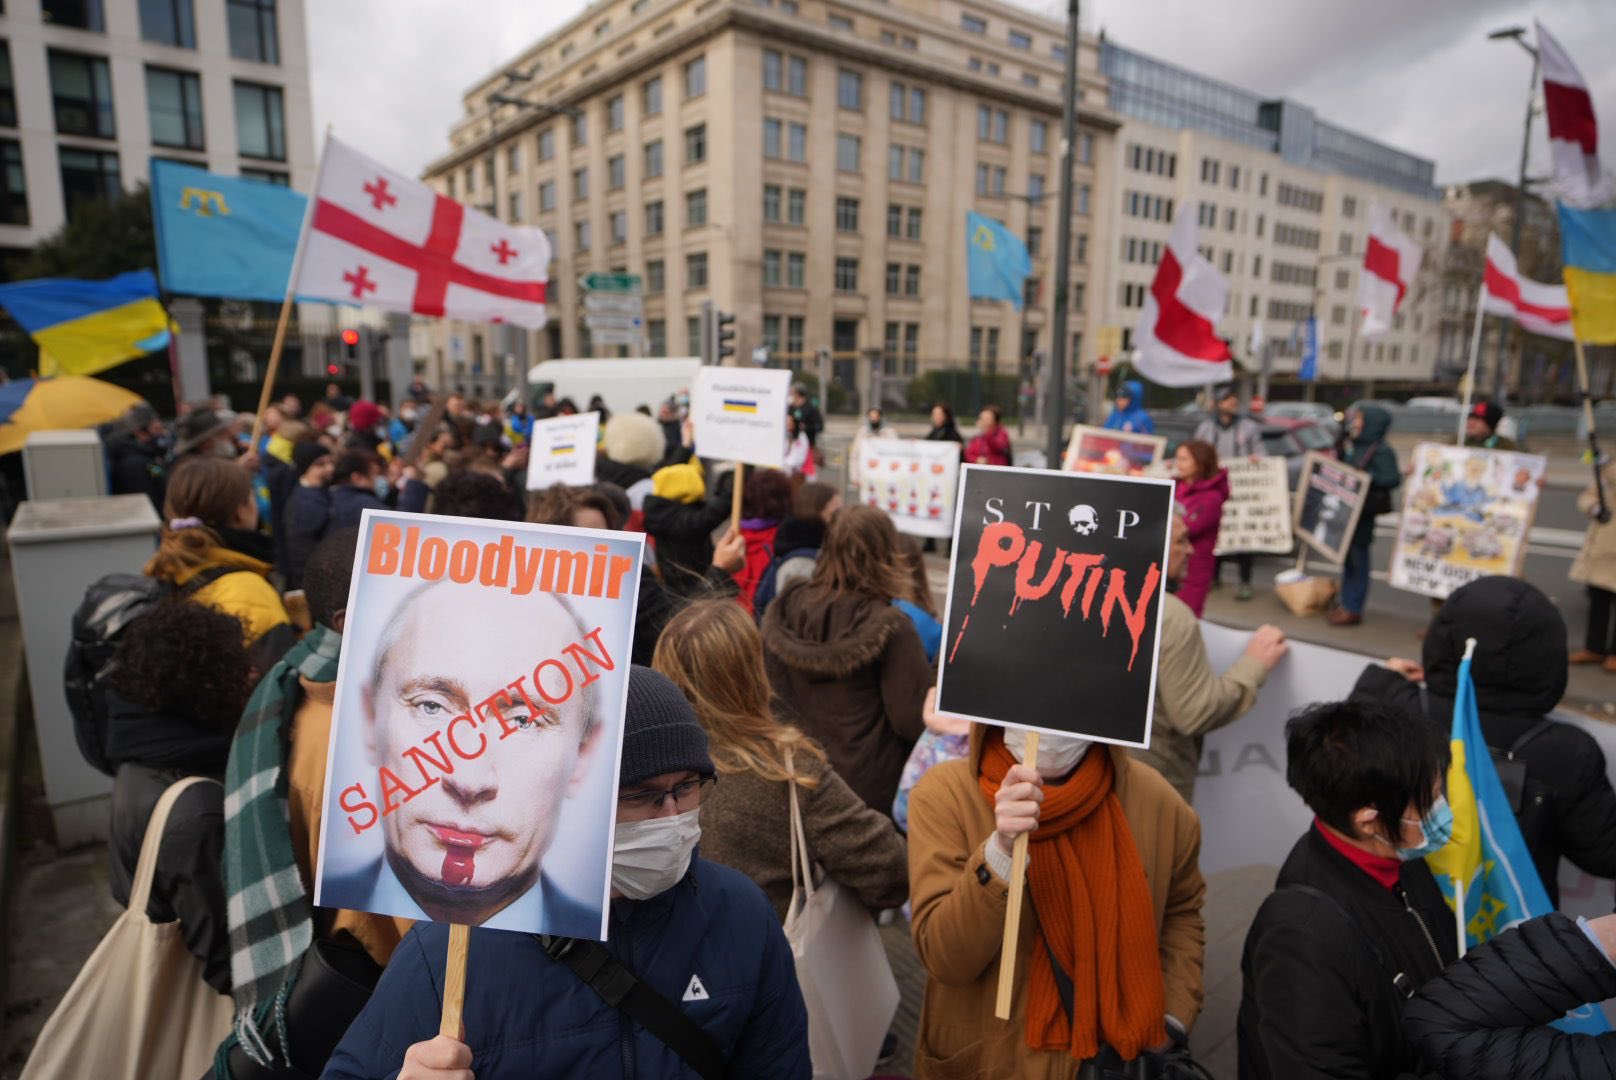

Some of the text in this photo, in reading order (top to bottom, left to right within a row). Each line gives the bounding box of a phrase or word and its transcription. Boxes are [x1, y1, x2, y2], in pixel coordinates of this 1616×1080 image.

[367, 522, 633, 599] Bloodymir
[949, 521, 1161, 671] PUTIN
[339, 627, 615, 834] SANCTION
